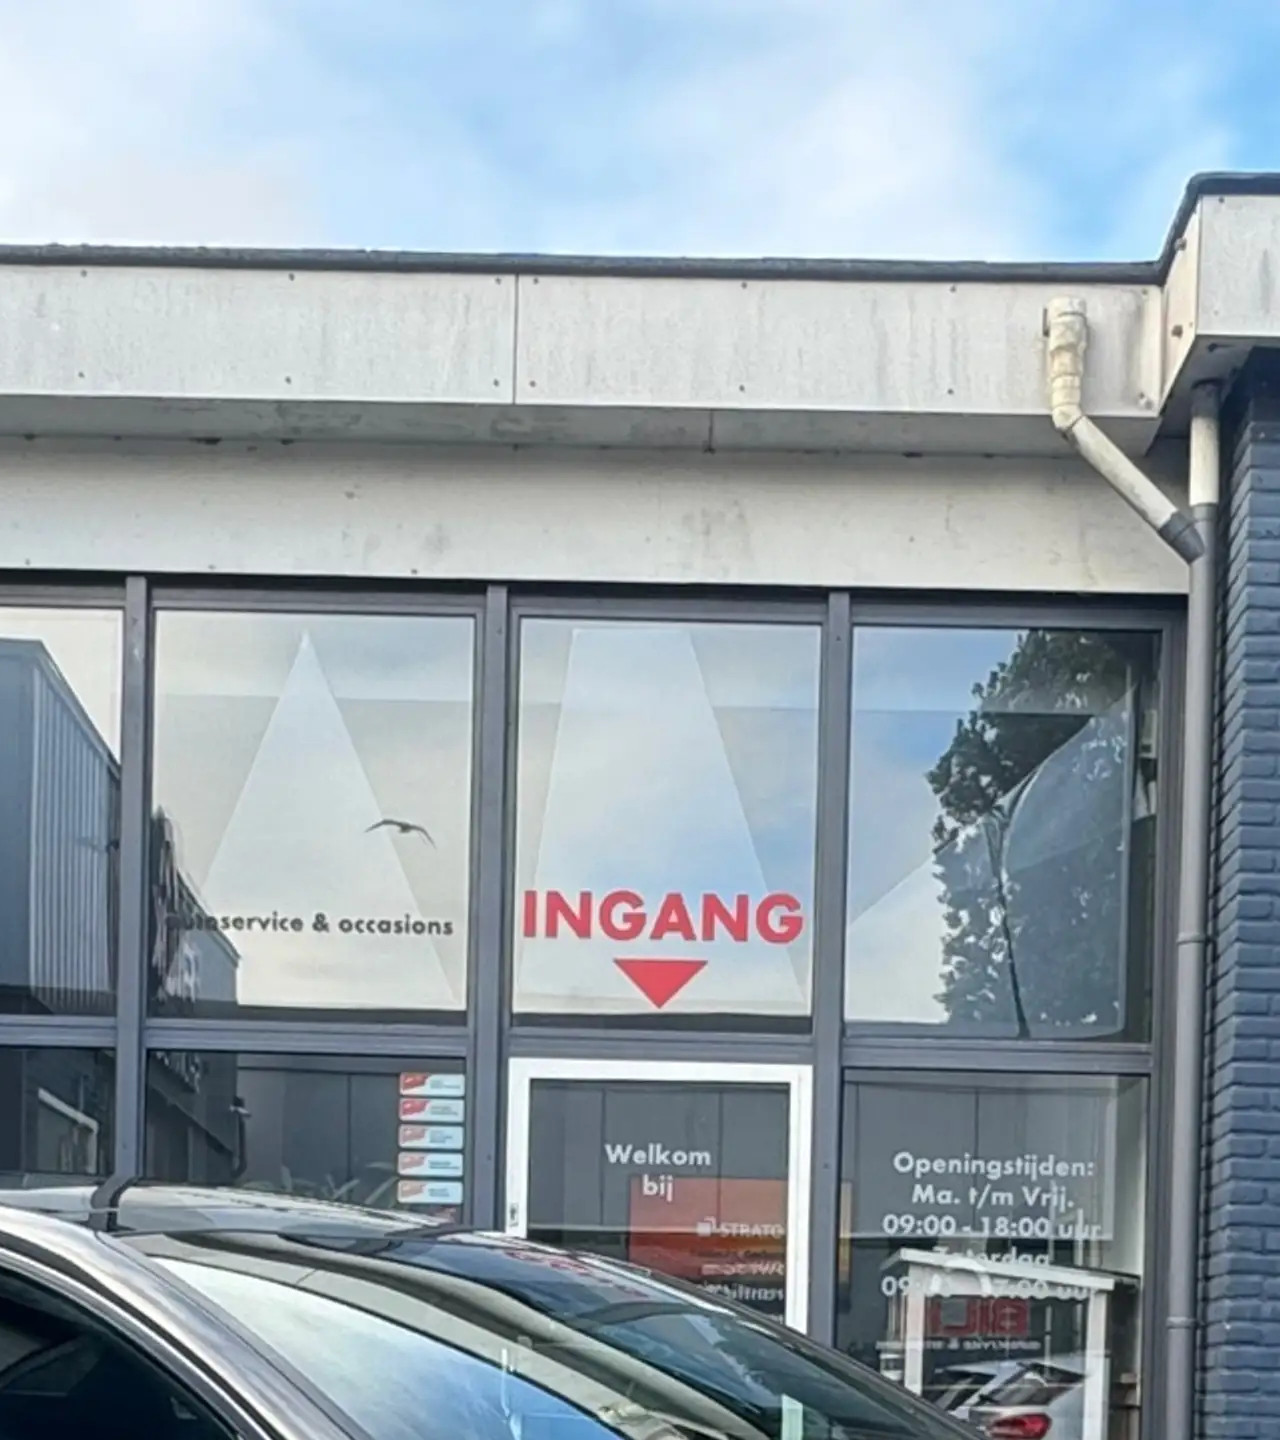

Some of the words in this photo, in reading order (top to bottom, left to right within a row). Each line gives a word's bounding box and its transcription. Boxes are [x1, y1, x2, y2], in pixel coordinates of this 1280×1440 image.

[312, 912, 330, 933] &
[338, 914, 454, 936] occasions
[523, 890, 804, 944] INGANG
[604, 1143, 711, 1166] Welkom
[893, 1151, 1095, 1181] Openingstijden:
[642, 1174, 673, 1202] bij
[911, 1184, 961, 1205] Ma.
[968, 1184, 1014, 1210] t/m
[1021, 1185, 1075, 1213] Vrij.
[882, 1214, 957, 1236] 09:00
[980, 1216, 1051, 1238] 18:00
[1057, 1222, 1103, 1239] uur
[931, 1246, 1050, 1268] erdag
